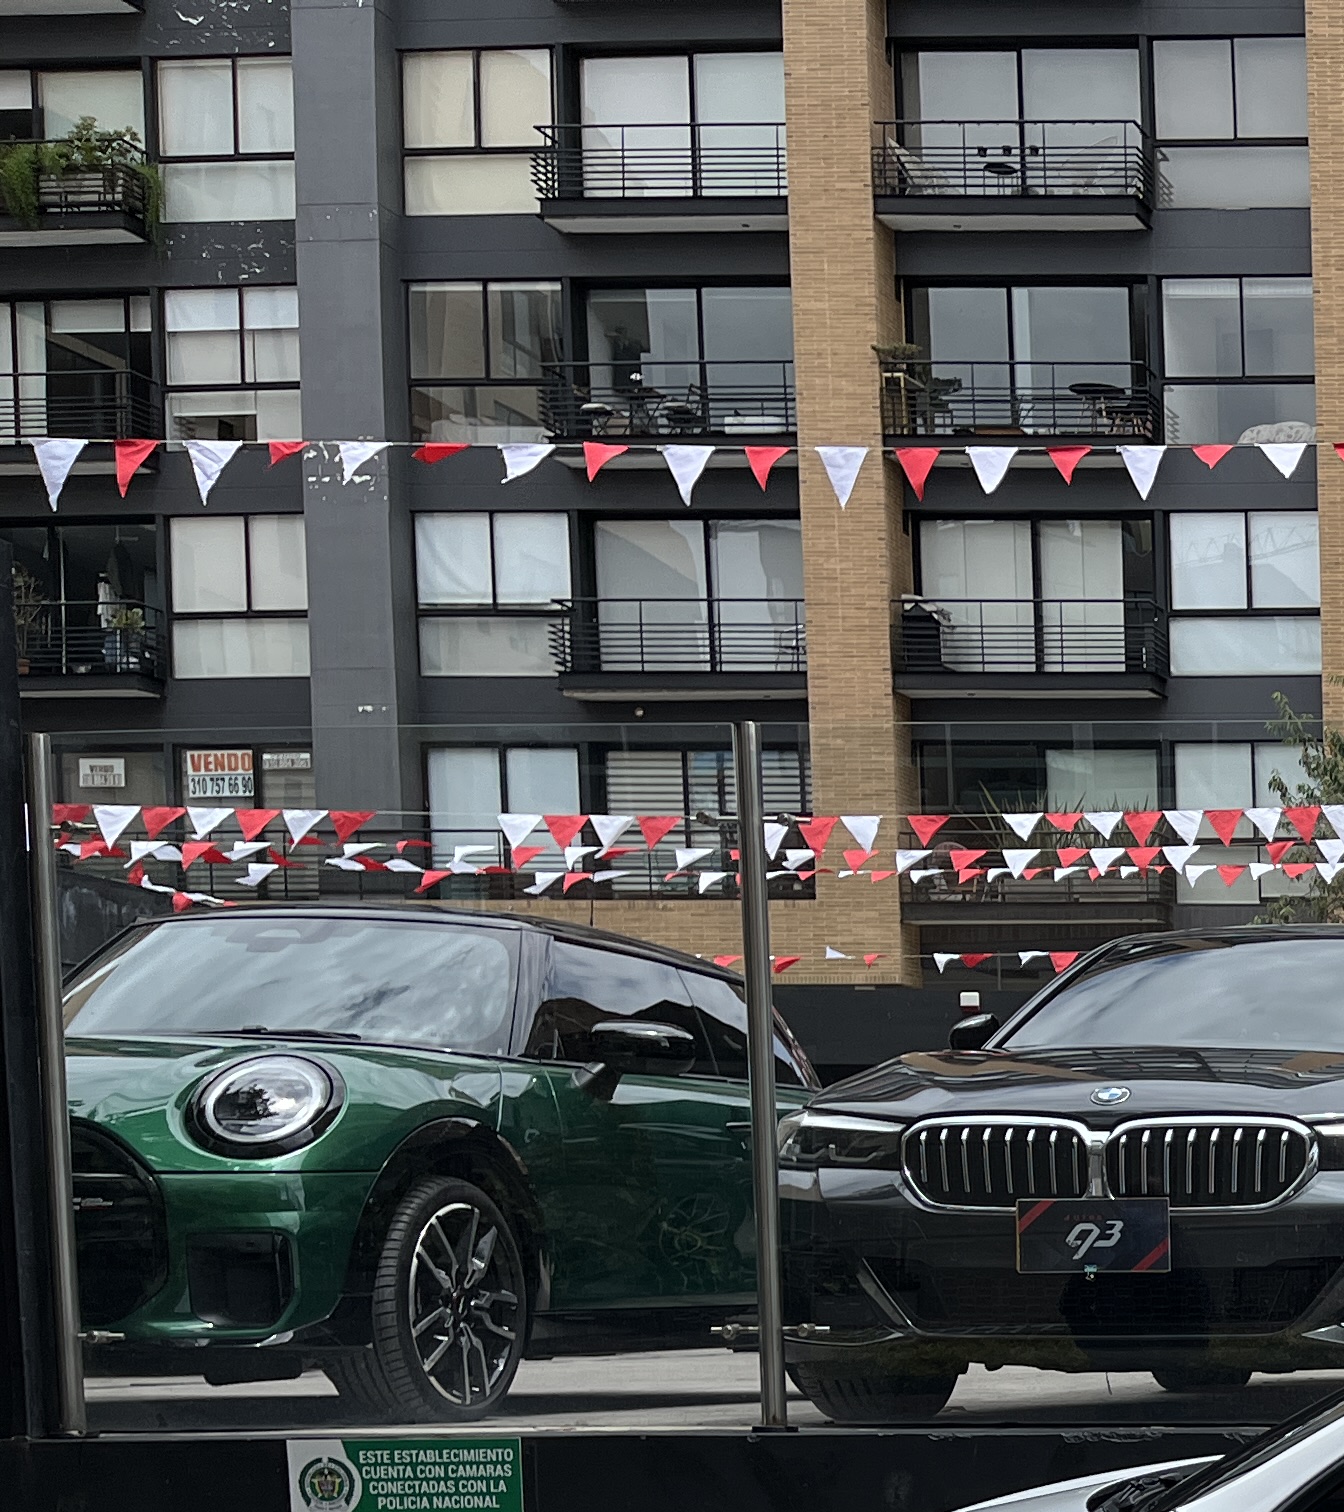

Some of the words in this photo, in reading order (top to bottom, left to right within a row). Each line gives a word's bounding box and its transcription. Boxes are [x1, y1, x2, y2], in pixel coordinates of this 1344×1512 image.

[190, 752, 253, 772] VENDO
[191, 777, 208, 795] 310
[210, 777, 225, 795] 757
[228, 776, 239, 794] 66
[241, 776, 253, 794] 90
[1065, 1220, 1124, 1260] 93
[359, 1450, 391, 1464] ESTE
[394, 1448, 514, 1463] ESTABLECIMIENTO
[362, 1465, 414, 1479] CUENTA
[416, 1465, 446, 1479] CON
[448, 1464, 513, 1478] CAMARAS
[369, 1481, 456, 1495] CONECTADAS
[458, 1480, 488, 1494] CON
[490, 1479, 507, 1493] LA
[377, 1496, 430, 1510] POLICIA
[433, 1495, 500, 1509] NACIONAL
